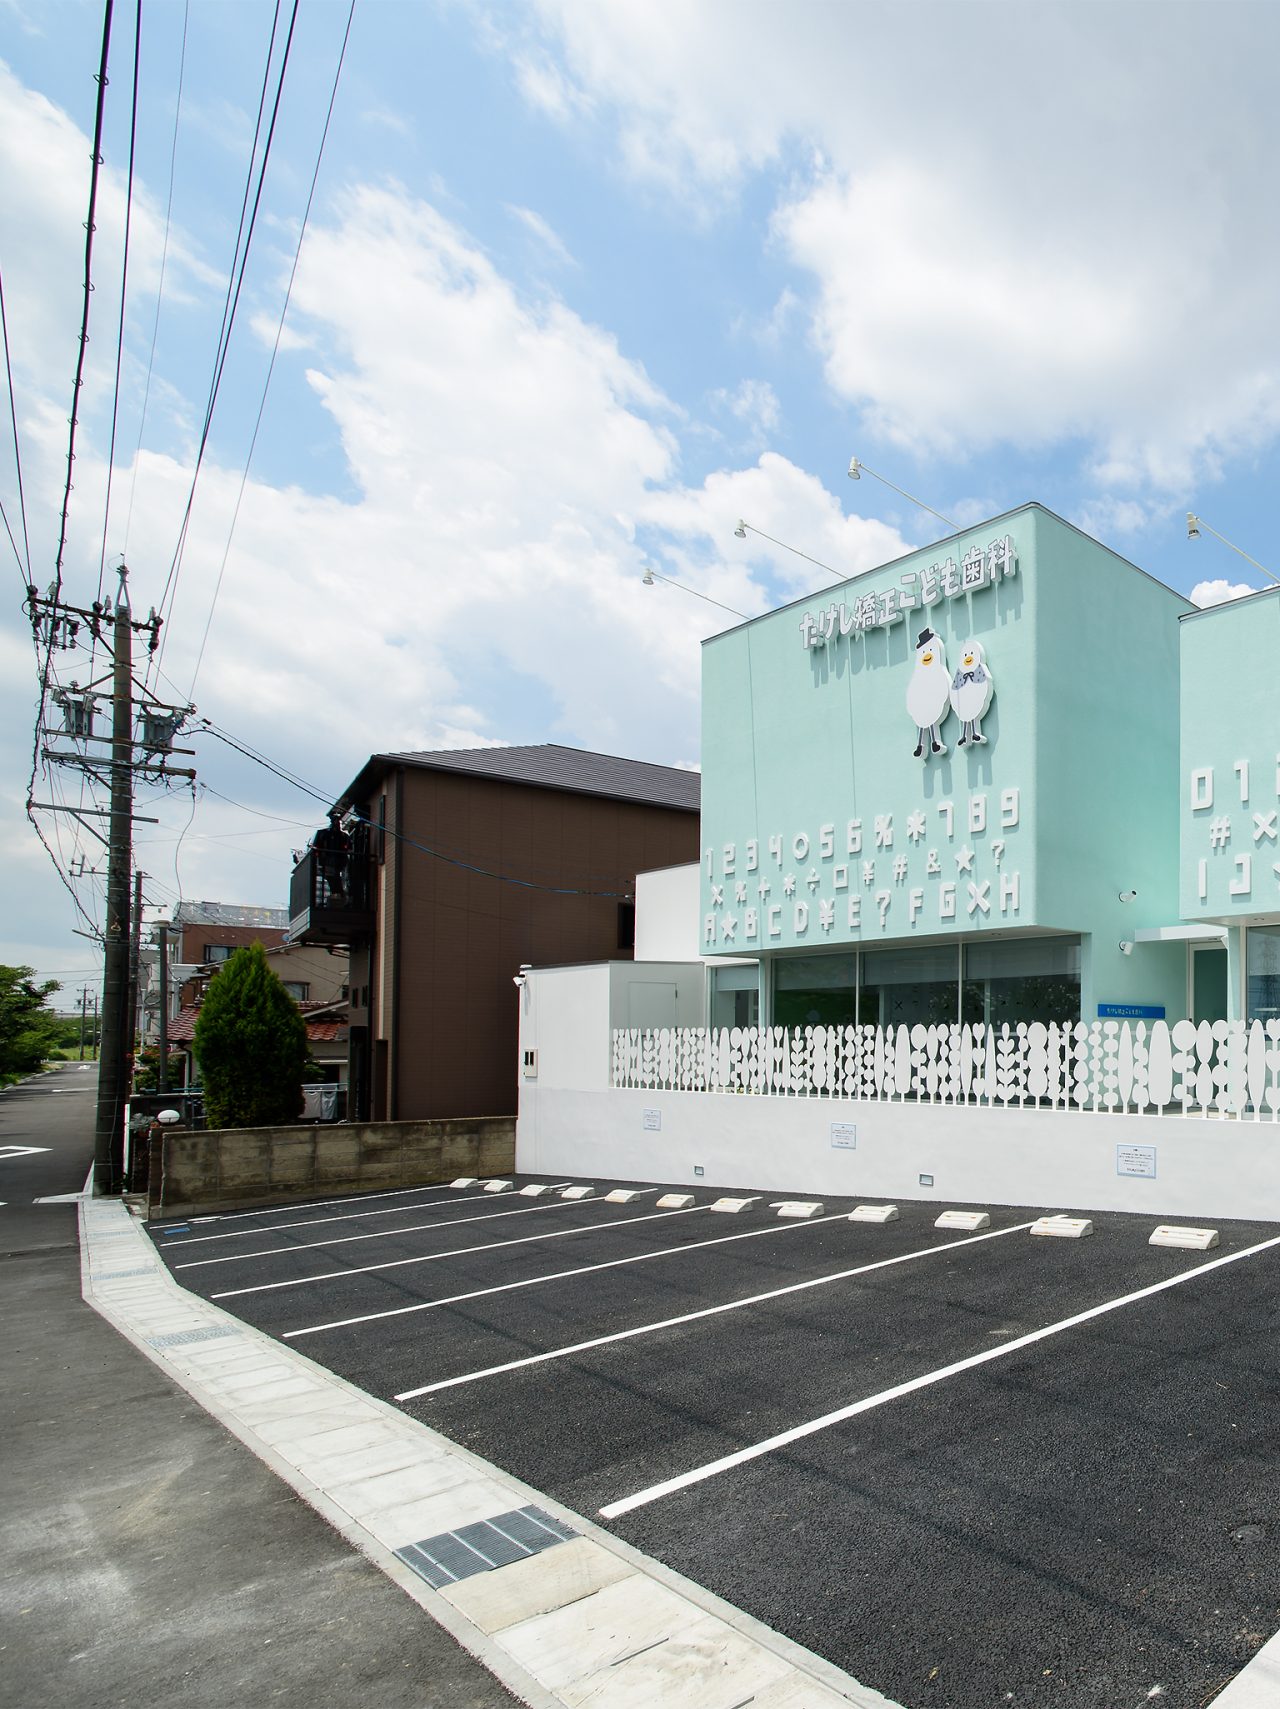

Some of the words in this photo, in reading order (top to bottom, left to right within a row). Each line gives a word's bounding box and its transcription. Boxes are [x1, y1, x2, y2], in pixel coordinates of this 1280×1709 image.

[800, 534, 1019, 650] たけし矯正こども歯科
